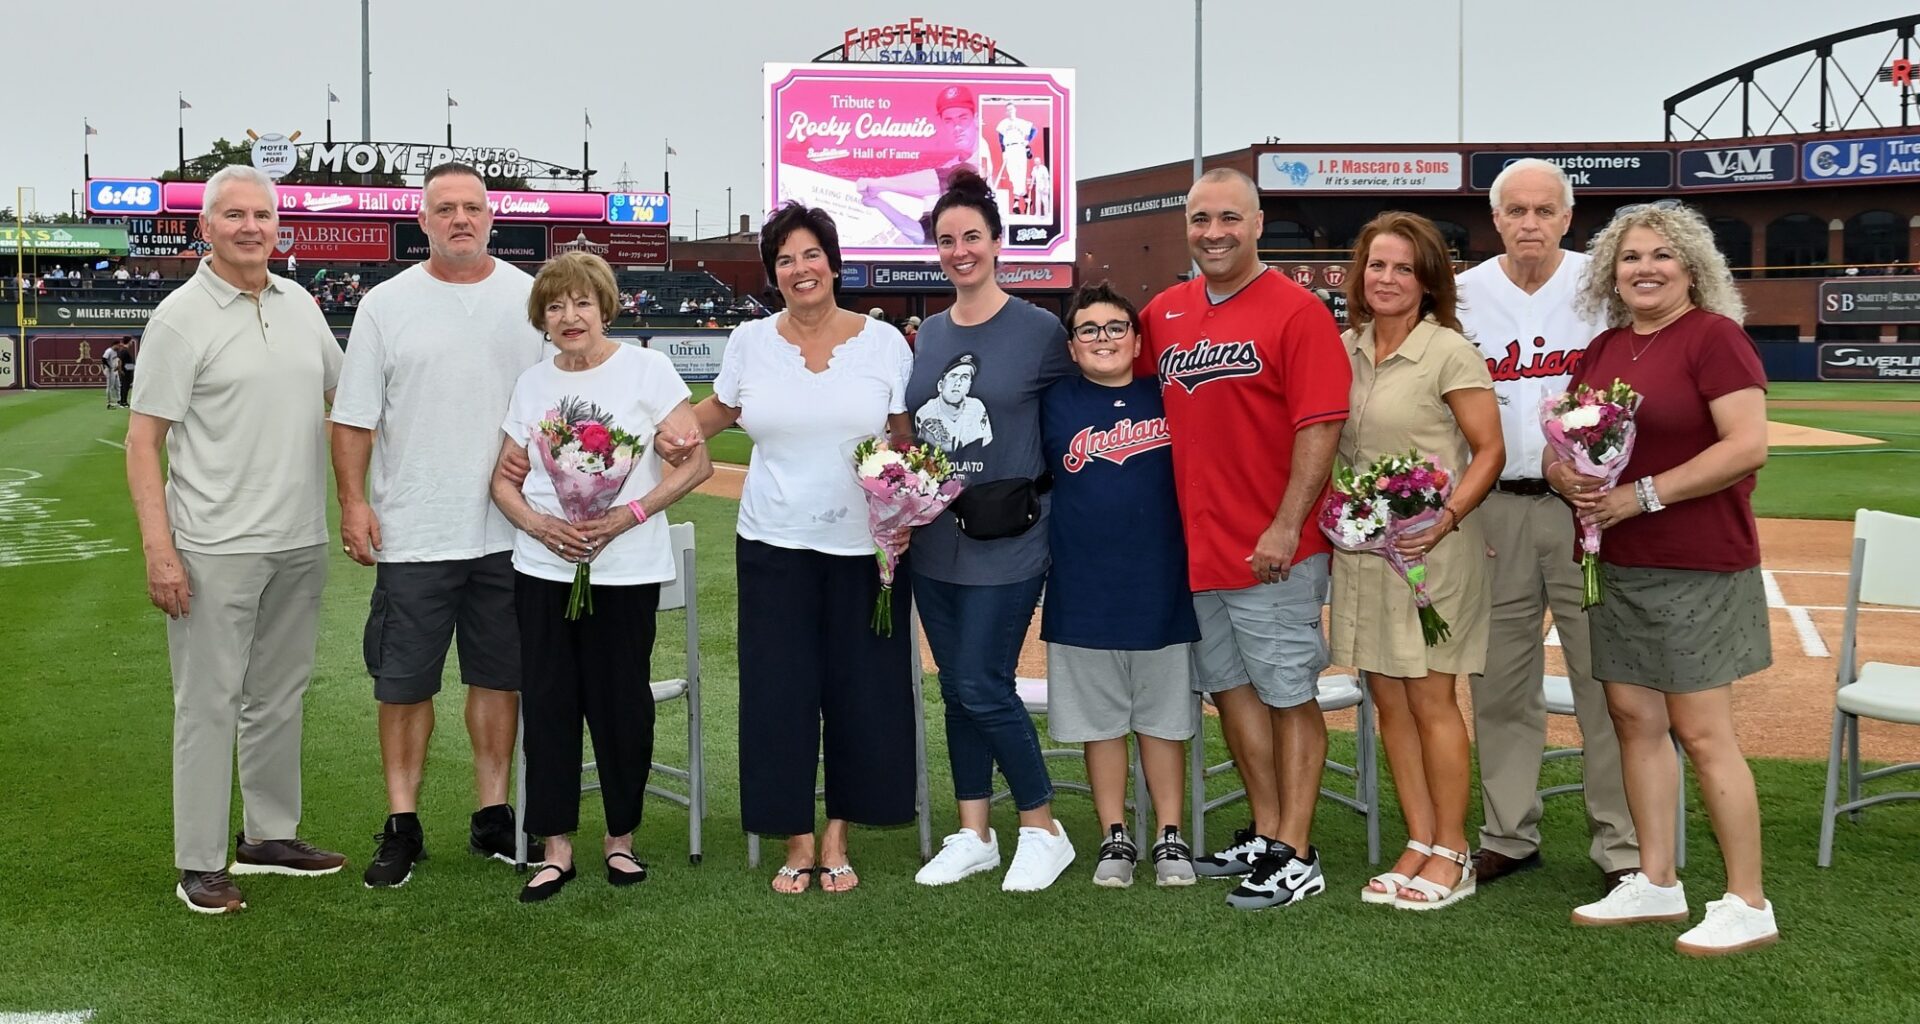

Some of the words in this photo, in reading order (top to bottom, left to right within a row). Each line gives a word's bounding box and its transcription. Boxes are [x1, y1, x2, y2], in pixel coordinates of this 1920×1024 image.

[880, 49, 963, 64] STADIUM
[830, 94, 875, 109] Tribute
[878, 97, 891, 109] to
[786, 111, 852, 145] Rocky
[855, 113, 937, 139] Colavito
[309, 143, 454, 177] MOYER
[461, 147, 519, 162] AUTO
[853, 148, 874, 159] Hall
[876, 148, 888, 159] of
[889, 149, 920, 159] Famer
[1809, 144, 1878, 177] CJ's
[465, 162, 529, 178] ROUP
[1317, 160, 1327, 174] J.
[1330, 160, 1339, 174] P.
[1342, 160, 1401, 174] Mascaro
[1403, 161, 1413, 174] &
[1416, 160, 1449, 174] Sons
[1325, 177, 1332, 185] If
[1335, 177, 1350, 185] it's
[1352, 177, 1390, 187] service,
[1393, 177, 1408, 185] it's
[1410, 177, 1426, 185] us!
[1562, 171, 1591, 184] nk
[1733, 173, 1774, 182] TOWING
[97, 185, 152, 206] 6:48
[282, 193, 297, 209] to
[358, 193, 389, 210] Hall
[392, 194, 408, 211] of
[500, 195, 550, 214] Colavito
[1100, 203, 1133, 217] AMERICA'S
[1133, 199, 1160, 212] CLASSIC
[611, 206, 619, 221] $
[632, 206, 655, 221] 760
[157, 220, 187, 234] FIRE
[295, 226, 387, 243] ALBRIGHT
[151, 235, 187, 244] COOLING
[498, 248, 535, 256] BANKING
[555, 244, 609, 255] HIGHLANDS
[1297, 272, 1310, 284] 14
[1329, 273, 1341, 284] 17
[1856, 293, 1888, 302] SMITH
[669, 344, 711, 356] Unruh
[1158, 338, 1263, 392] Indians
[1473, 336, 1587, 382] ndian
[1063, 418, 1172, 473] Indian
